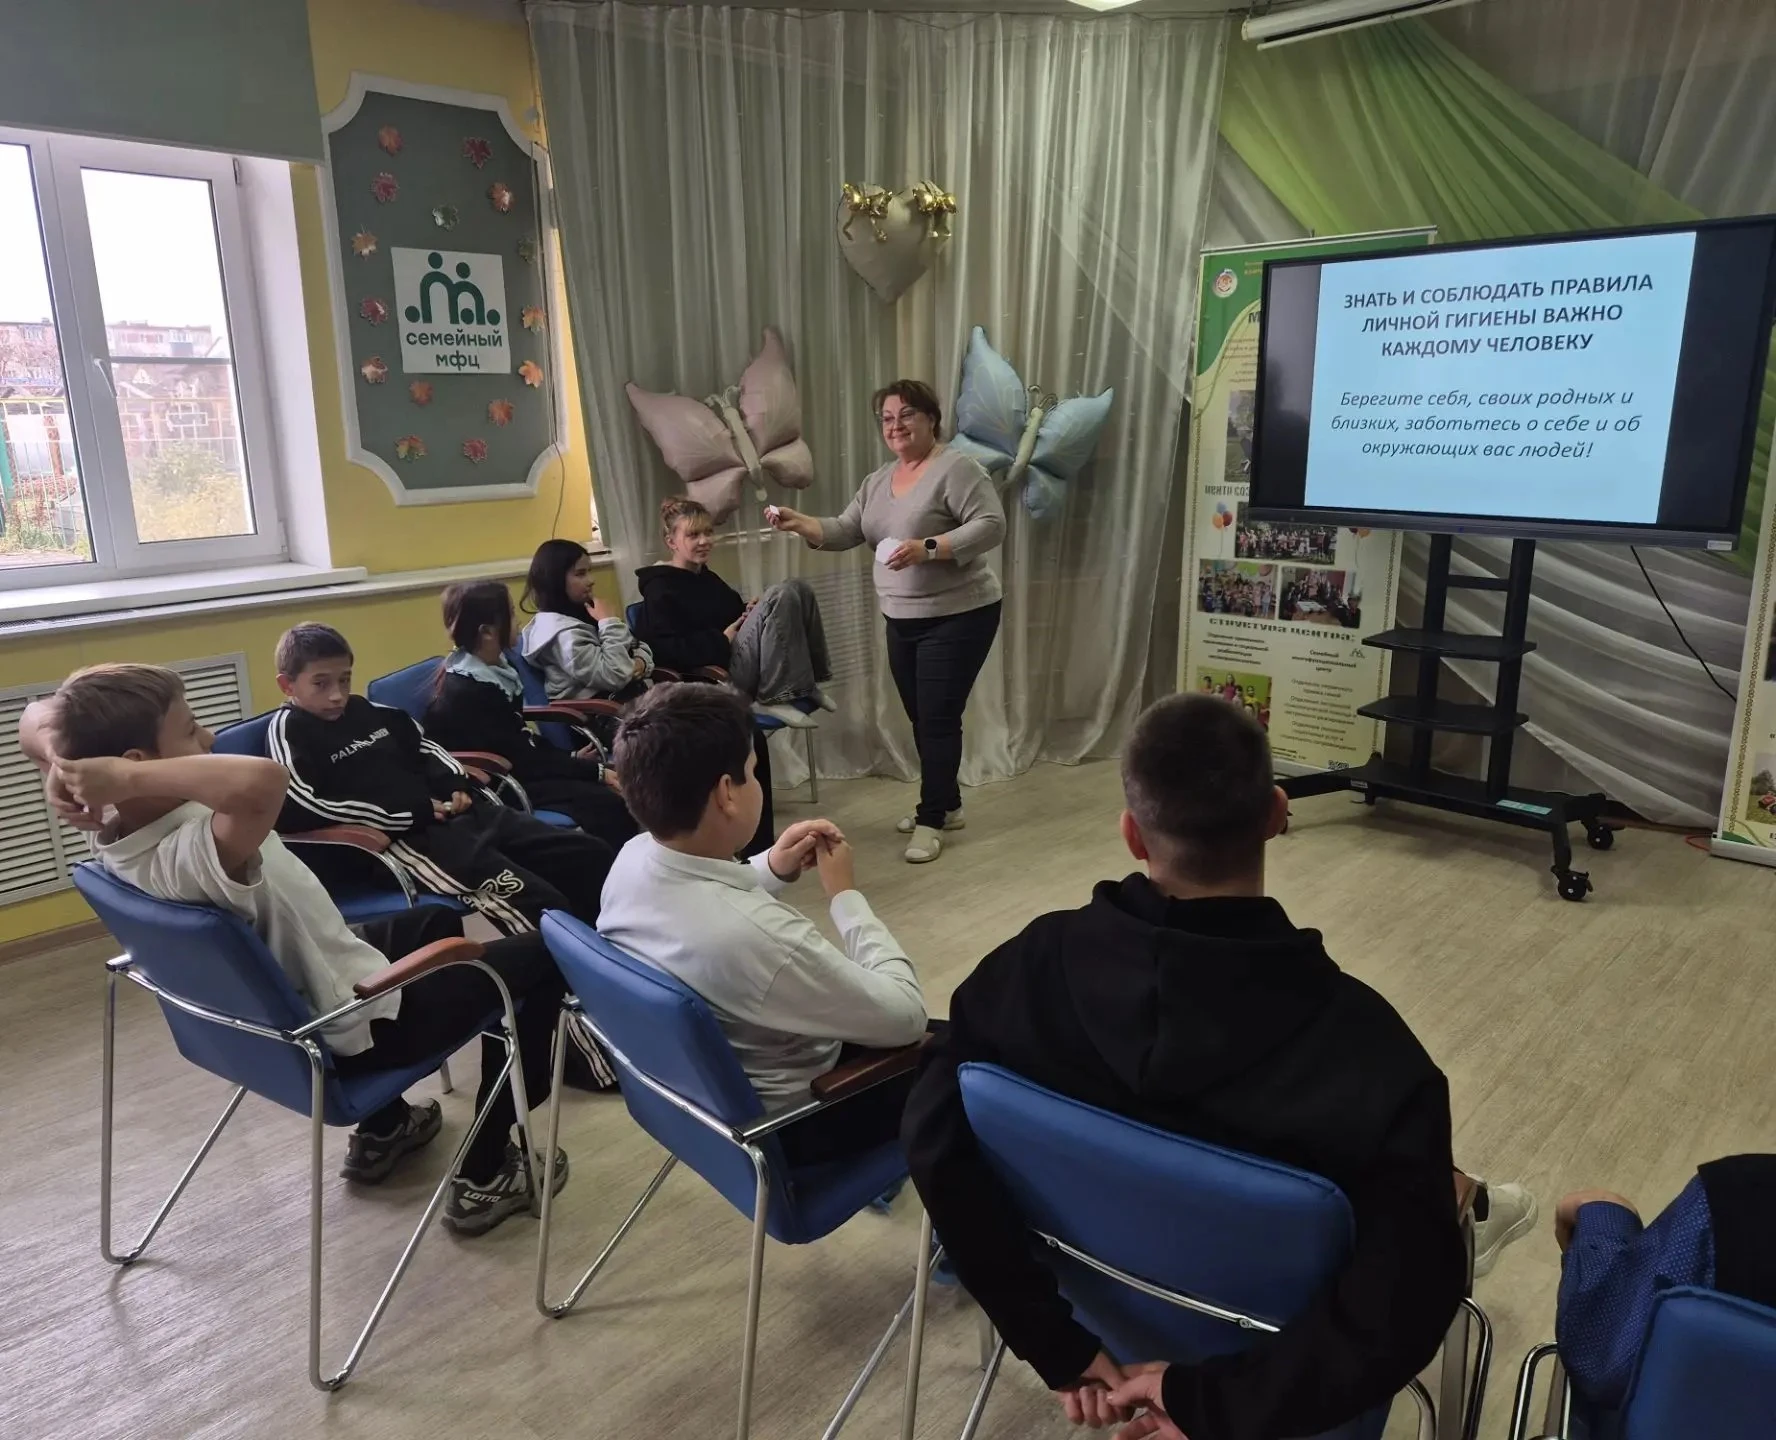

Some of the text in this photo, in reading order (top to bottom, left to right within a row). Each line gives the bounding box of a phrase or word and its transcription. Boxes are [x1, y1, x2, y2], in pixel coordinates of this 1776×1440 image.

[1344, 274, 1653, 309] ЗНАТЬ И СОБЛЮДАТЬ ПРАВИЛА
[1362, 304, 1623, 332] ЛИЧНОЙ ГИГИЕНЫ ВАЖНО
[406, 329, 502, 347] семейный
[1382, 333, 1593, 358] КАЖДОМУ ЧЕЛОВЕКУ
[436, 350, 480, 371] мфц
[1341, 389, 1633, 408] Берегите себя, своих родных и
[1331, 415, 1642, 432] близких, заботьтесь о себе и об
[1362, 442, 1593, 458] окружающих вас людей!
[463, 1191, 502, 1203] LOTTO
